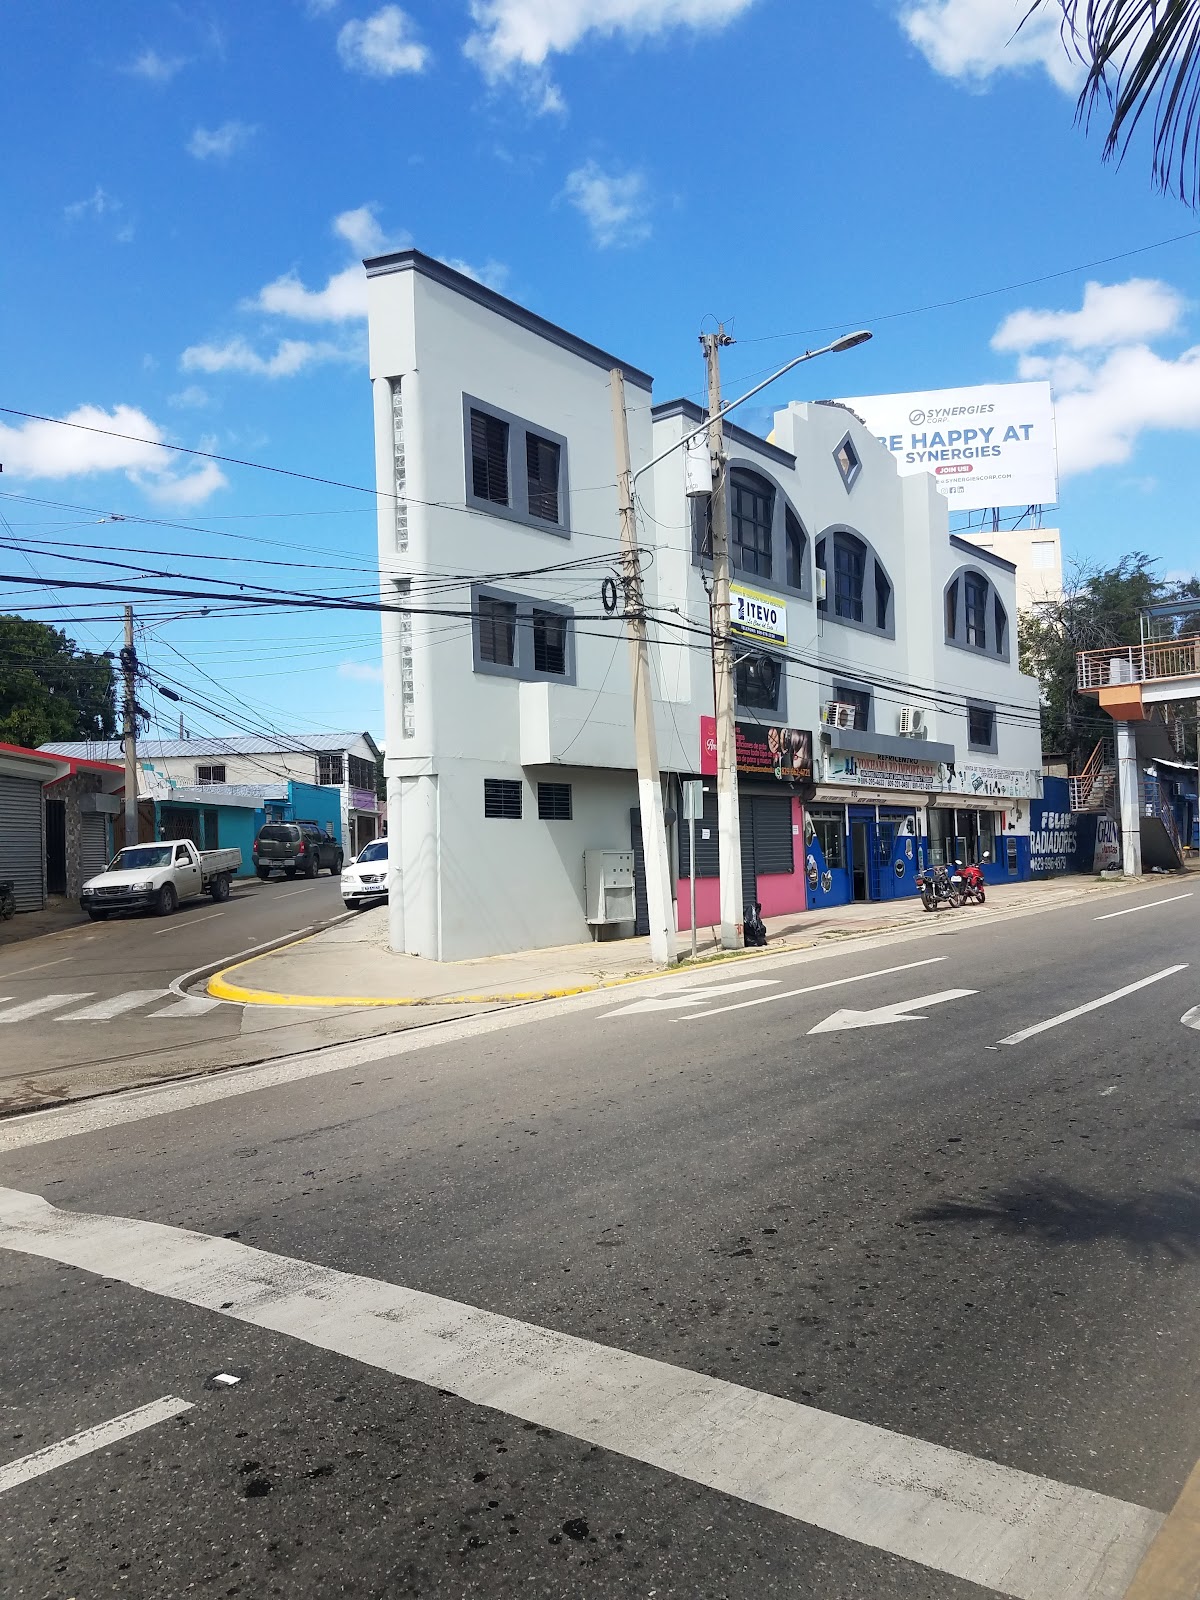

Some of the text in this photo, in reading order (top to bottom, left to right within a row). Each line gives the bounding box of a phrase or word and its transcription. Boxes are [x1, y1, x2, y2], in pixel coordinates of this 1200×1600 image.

[926, 404, 995, 418] SYNERGIES
[912, 427, 994, 450] HAPPY
[1002, 424, 1034, 442] AT
[906, 445, 1002, 464] SYNERGIES
[747, 602, 776, 624] ITEVO
[1030, 830, 1078, 854] RADIADORES
